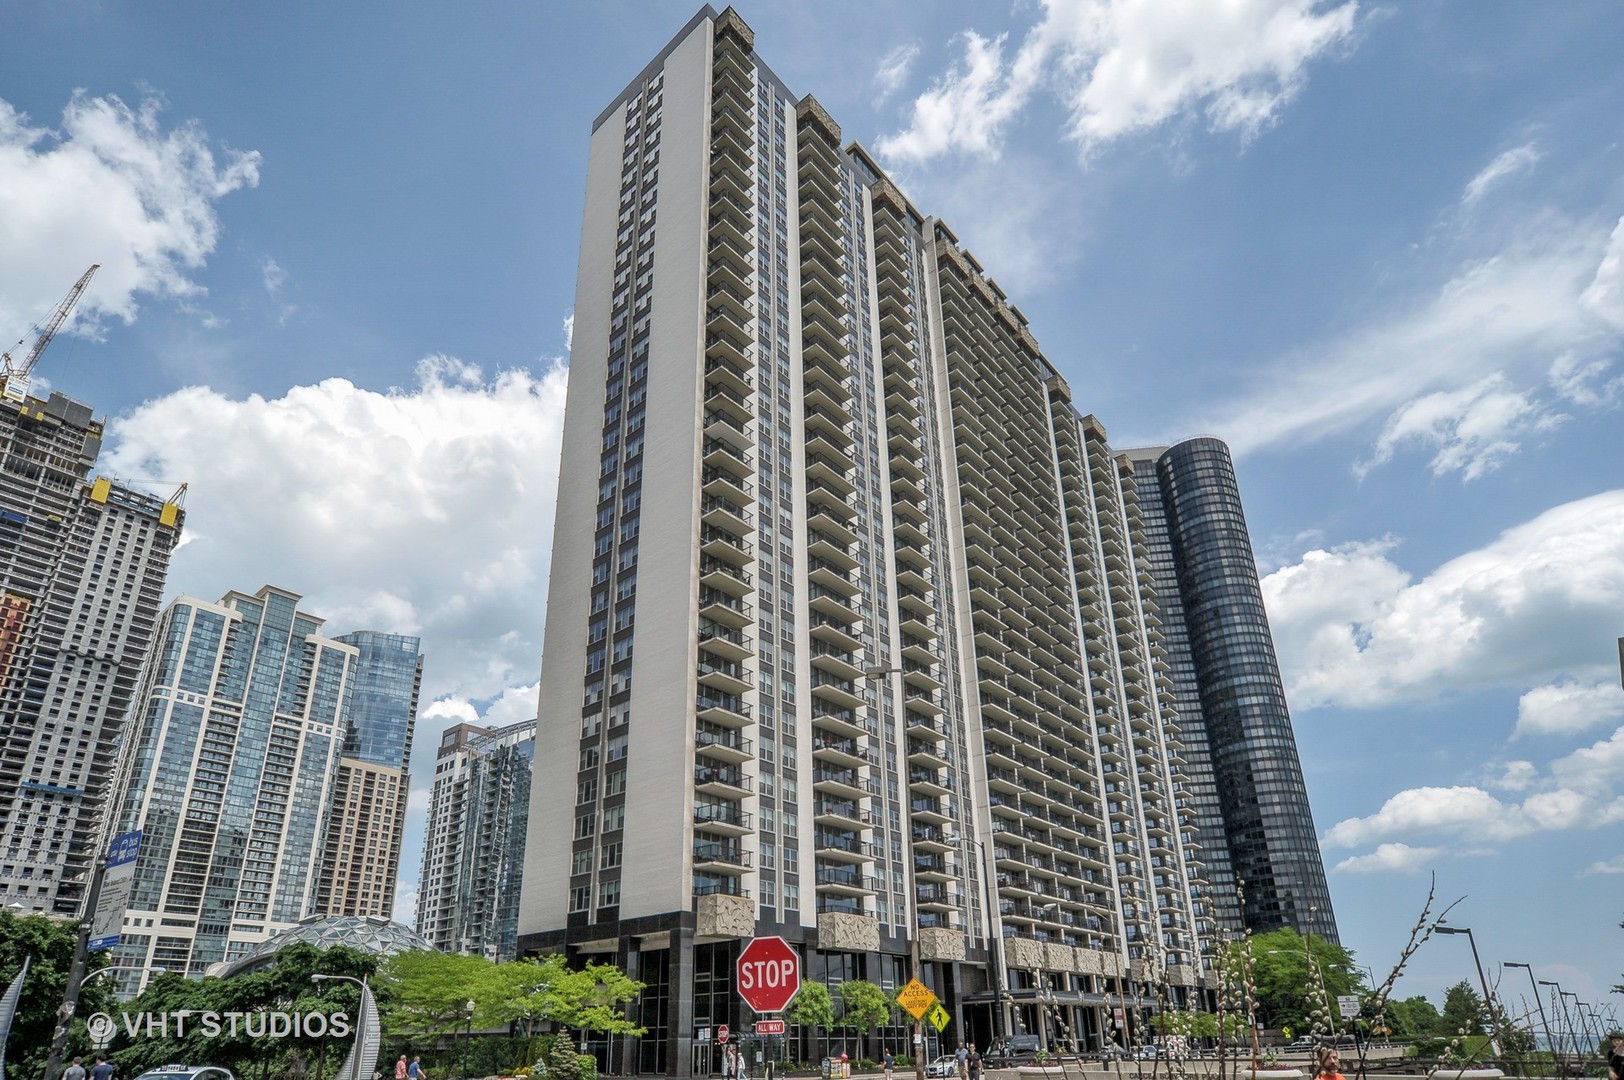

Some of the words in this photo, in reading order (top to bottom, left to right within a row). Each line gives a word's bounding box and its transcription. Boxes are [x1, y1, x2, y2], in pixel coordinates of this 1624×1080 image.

[129, 837, 138, 847] bus
[126, 848, 138, 859] stop
[742, 960, 794, 989] STOP
[758, 1024, 767, 1032] ALL
[768, 1023, 781, 1031] WAY
